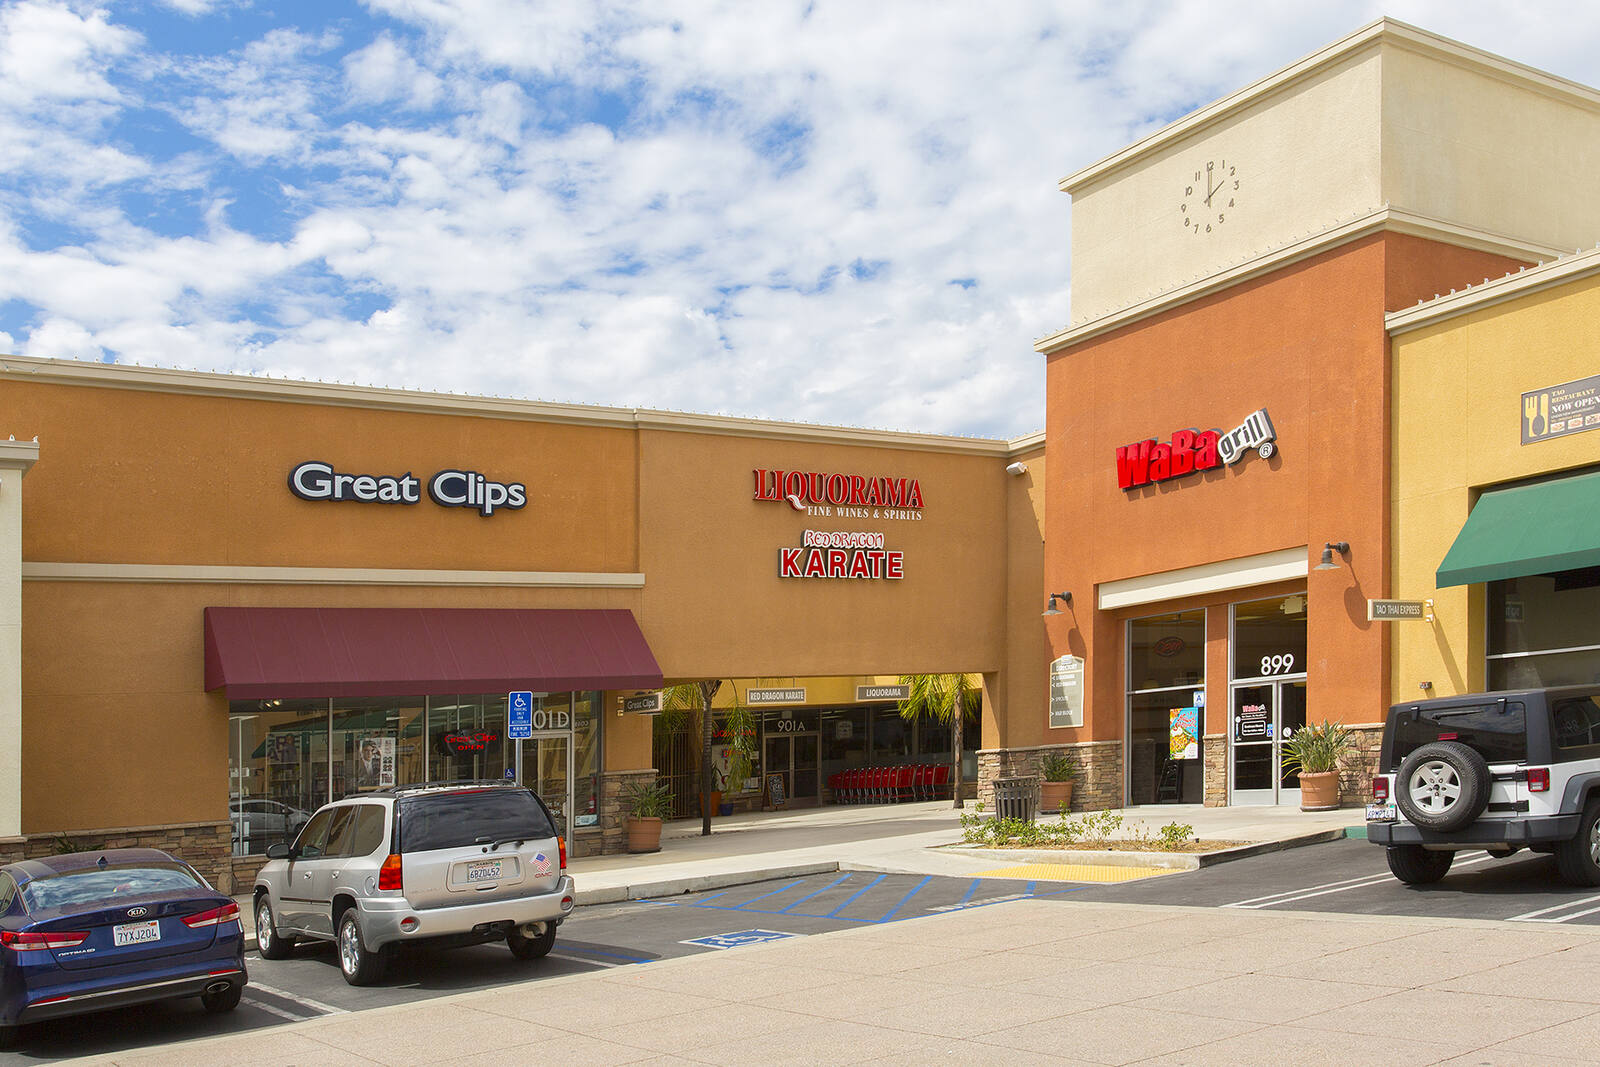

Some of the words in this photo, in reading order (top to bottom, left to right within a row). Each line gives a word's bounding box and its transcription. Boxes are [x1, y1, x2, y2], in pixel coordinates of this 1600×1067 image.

[1230, 166, 1236, 176] 2
[1233, 180, 1240, 191] 3
[1228, 197, 1235, 208] 4
[1218, 213, 1225, 224] 5
[1551, 401, 1572, 414] NOW
[1115, 429, 1222, 489] WaBa
[1218, 411, 1271, 463] grill
[291, 462, 420, 503] Great
[431, 470, 526, 515] Clips
[753, 469, 925, 511] LIQUORAMA
[807, 506, 832, 517] FINE
[836, 507, 869, 519] WINES
[872, 509, 880, 519] &
[883, 509, 922, 521] SPIRITS
[803, 529, 831, 548] RED
[780, 548, 904, 579] KARATE
[1376, 604, 1386, 615] TAO
[1400, 605, 1420, 615] EXPRESS
[1260, 653, 1295, 676] 899
[750, 691, 761, 701] RED
[761, 691, 784, 701] DRAGON
[785, 690, 804, 700] KARATE
[866, 688, 902, 697] LIQUORAMA
[627, 700, 642, 710] Great
[533, 709, 570, 729] 01D
[777, 720, 806, 732] 901A
[443, 734, 473, 744] Great
[473, 732, 497, 744] Clips
[130, 908, 146, 917] KIA
[117, 928, 157, 943] 7YXJ204
